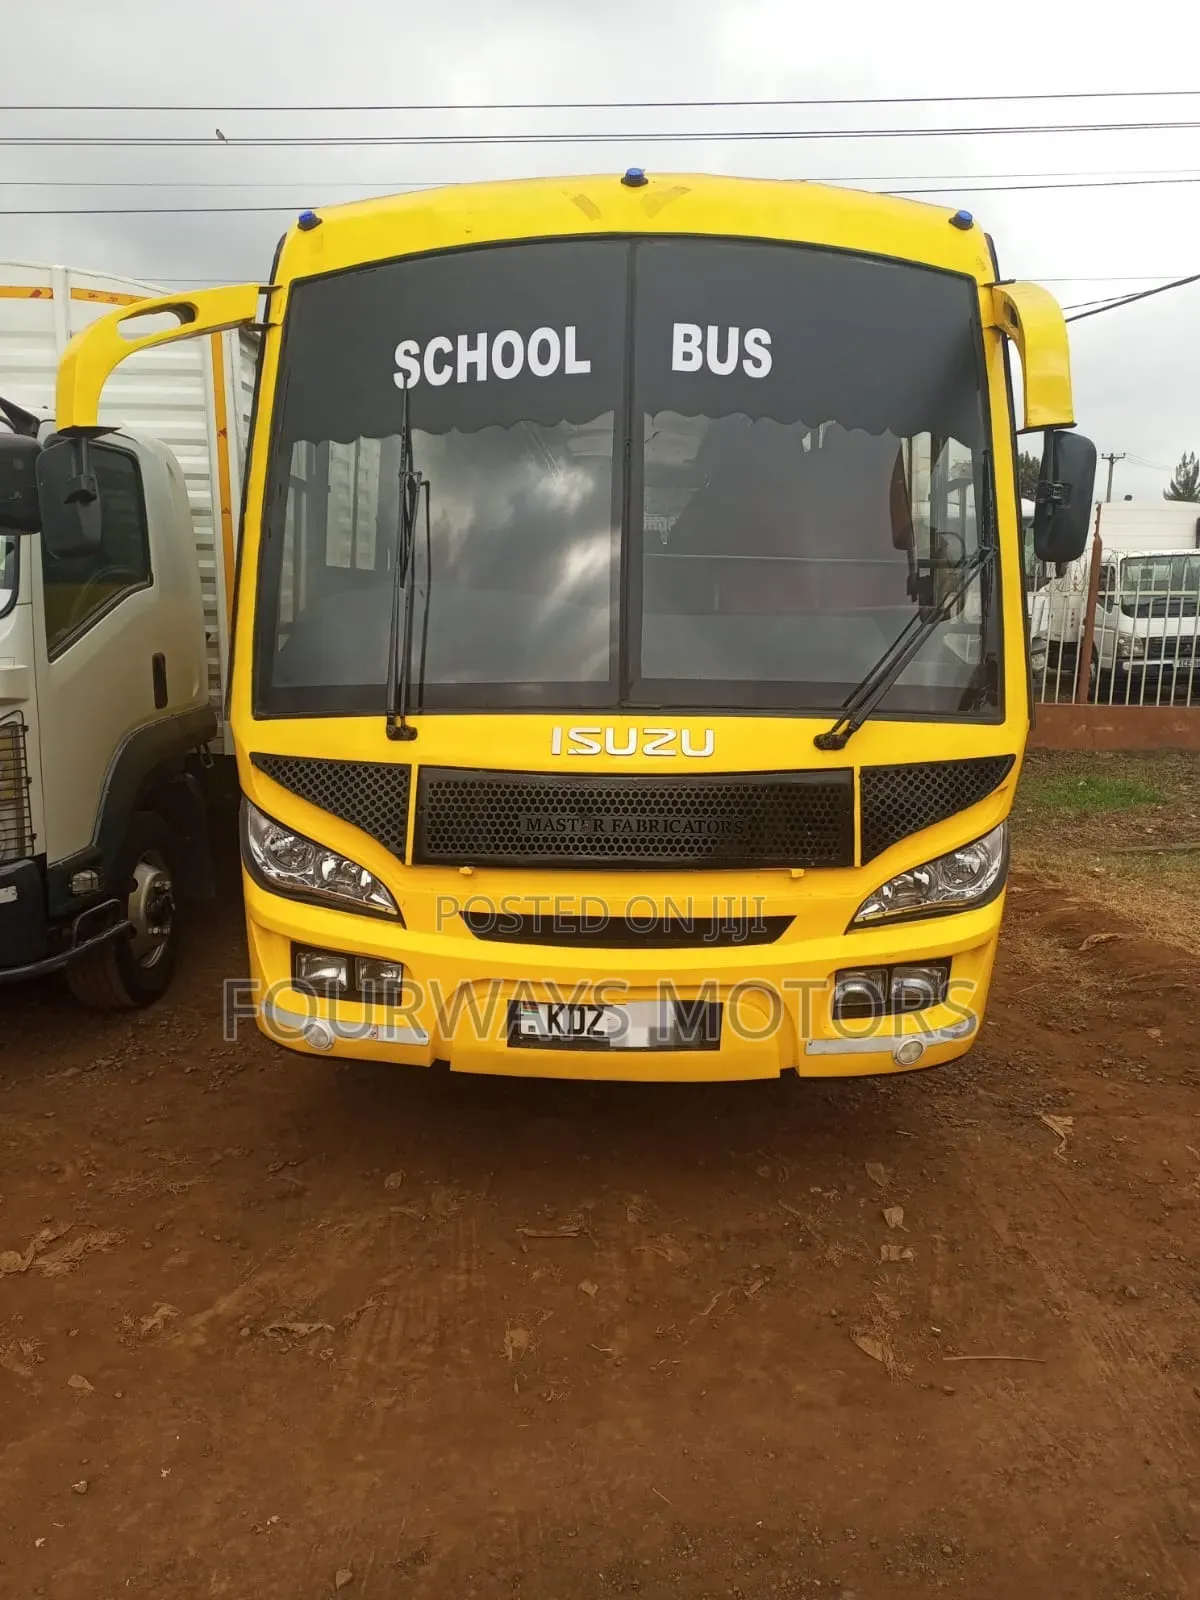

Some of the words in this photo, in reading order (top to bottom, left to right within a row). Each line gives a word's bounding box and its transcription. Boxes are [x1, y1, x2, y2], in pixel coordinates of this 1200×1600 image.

[393, 326, 591, 389] SCHOOL
[672, 323, 772, 378] BUS
[551, 727, 715, 757] ISUZU
[612, 818, 744, 834] FABRICATORS
[547, 1005, 605, 1036] KDZ
